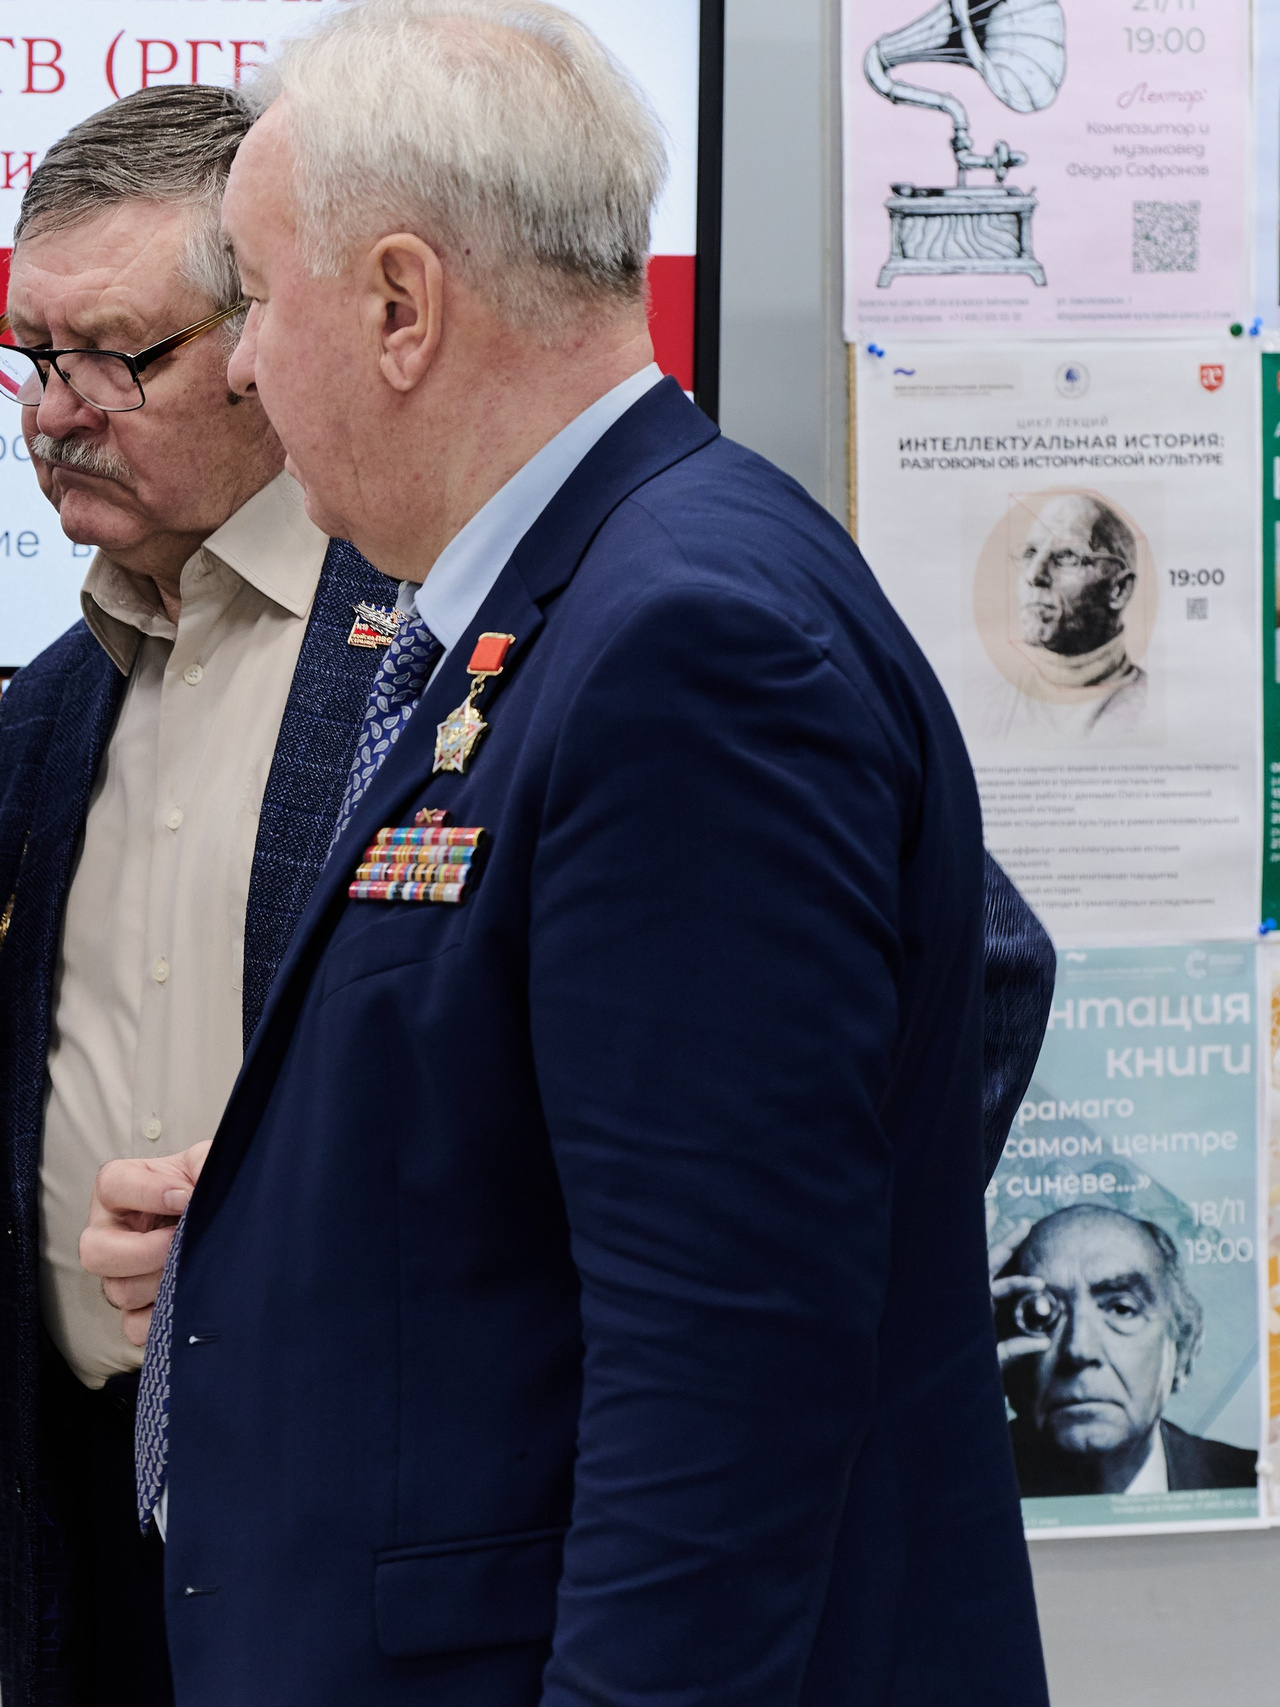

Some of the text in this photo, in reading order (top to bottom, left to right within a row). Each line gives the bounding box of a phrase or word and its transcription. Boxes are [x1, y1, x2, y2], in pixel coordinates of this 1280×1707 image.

[1122, 26, 1206, 55] 19:00
[1086, 121, 1209, 136] Композитор и
[1112, 144, 1205, 159] музыковед
[1125, 162, 1209, 179] Софронов
[1016, 414, 1109, 429] ЦИКЛ ЛЕКЦИЙ
[898, 433, 1225, 452] ИНТЕЛЛЕКТУАЛЬНАЯ ИСТОРИЯ:
[900, 452, 1224, 470] РАЗГОВОРЫ ОБ ИСТОРИЧЕСКОЙ КУЛЬТУРЕ
[1169, 568, 1225, 586] 19:00
[1048, 992, 1251, 1032] нтация
[1106, 1043, 1252, 1079] книги
[1017, 1098, 1135, 1127] рамаго
[1002, 1130, 1238, 1159] самом центре
[1190, 1196, 1246, 1228] 18/11
[1183, 1236, 1254, 1265] 19:00
